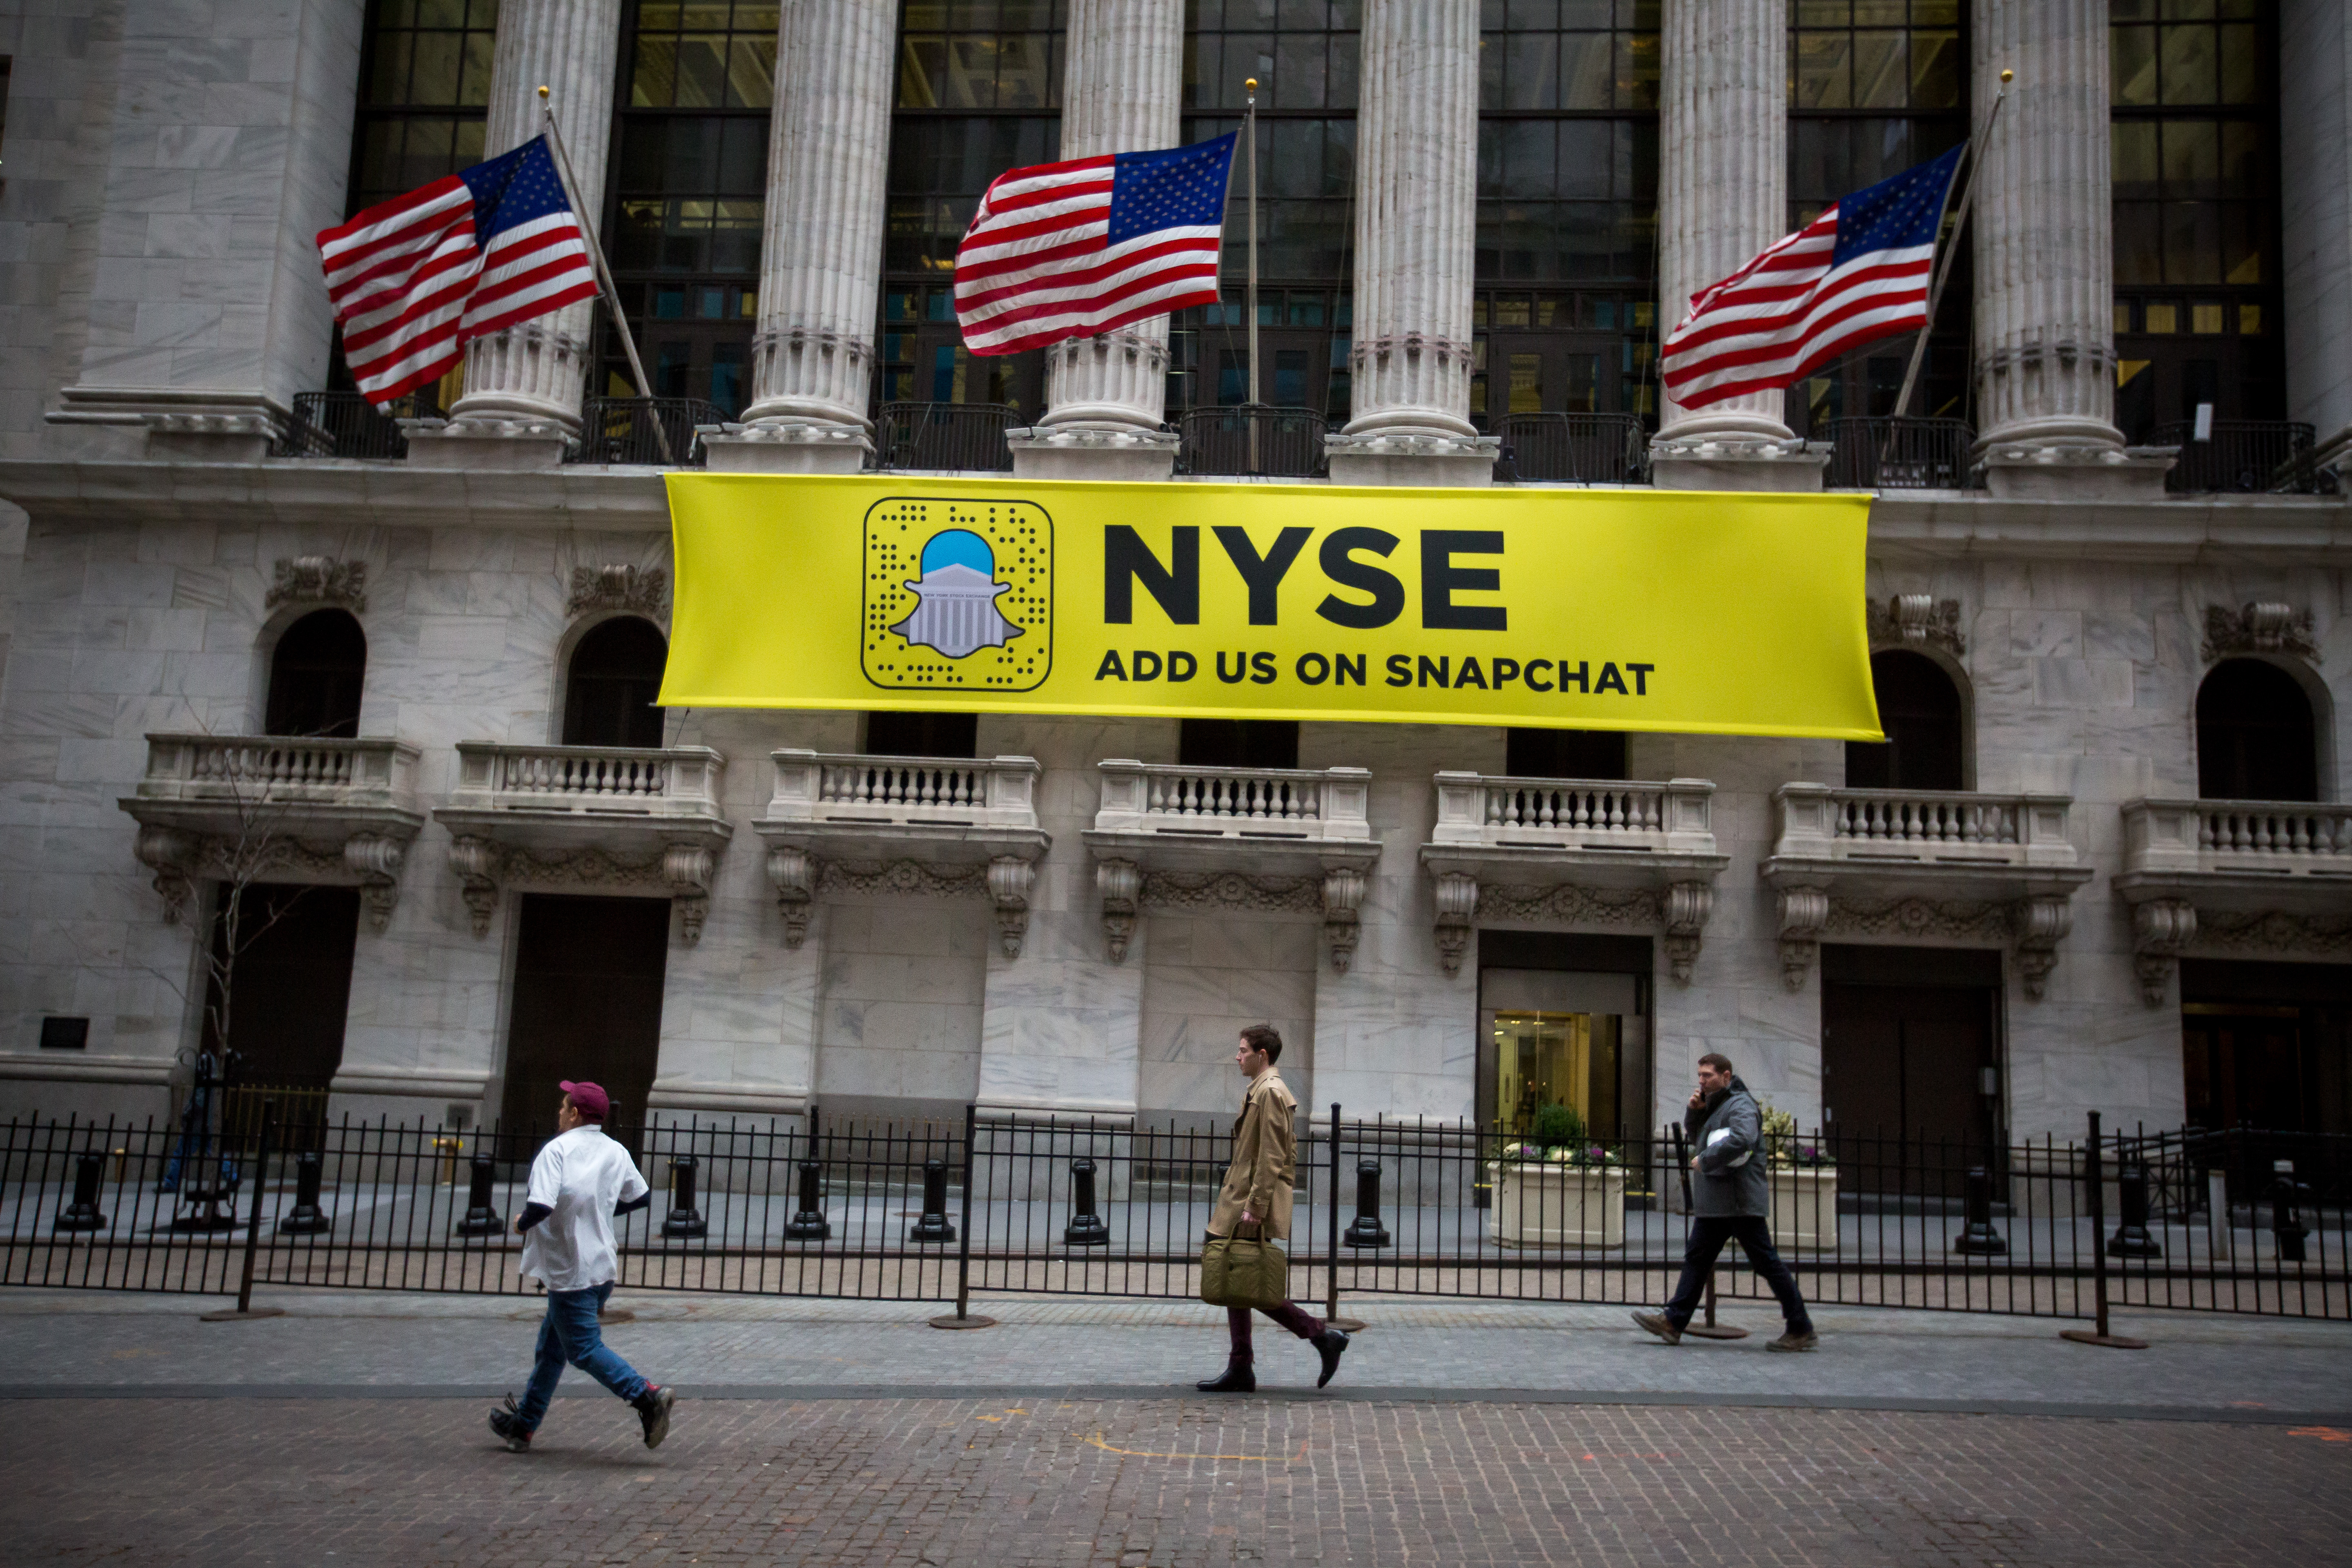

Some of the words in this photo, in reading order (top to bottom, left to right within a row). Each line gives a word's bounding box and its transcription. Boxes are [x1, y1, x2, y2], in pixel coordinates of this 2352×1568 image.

[1104, 525, 1508, 631] NYSE
[1095, 649, 1198, 682] ADD
[1216, 651, 1278, 685] US
[1296, 653, 1366, 686] ON
[1385, 654, 1655, 696] SNAPCHAT
